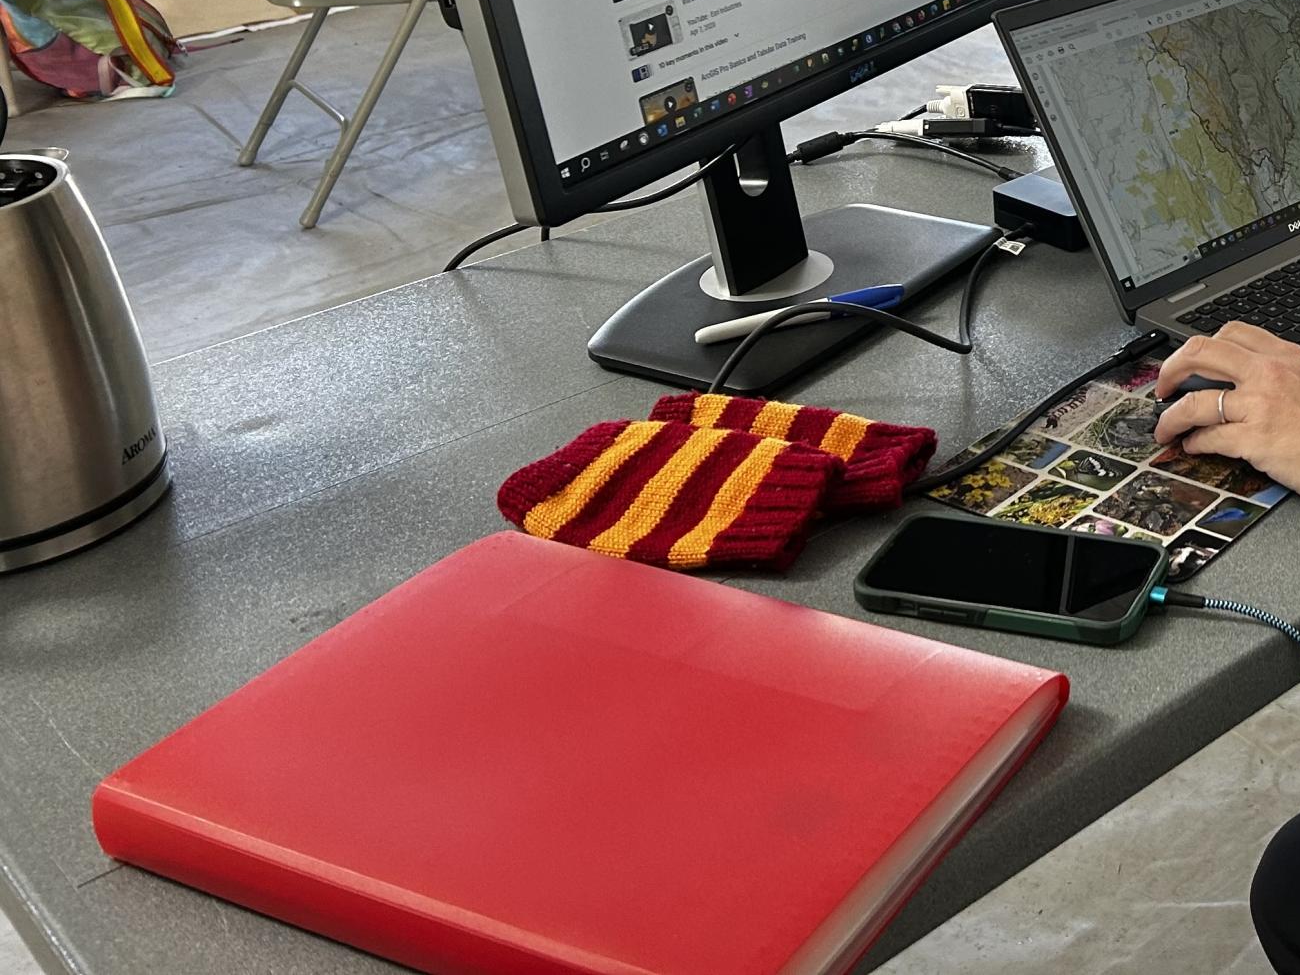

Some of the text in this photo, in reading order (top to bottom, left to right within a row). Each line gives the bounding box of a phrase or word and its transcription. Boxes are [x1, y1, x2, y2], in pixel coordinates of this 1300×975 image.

[666, 58, 676, 67] key
[676, 50, 699, 63] moments
[705, 43, 714, 51] this
[715, 37, 728, 48] video
[702, 32, 806, 81] ArcGIS Pro Basics and Tabular Data Training
